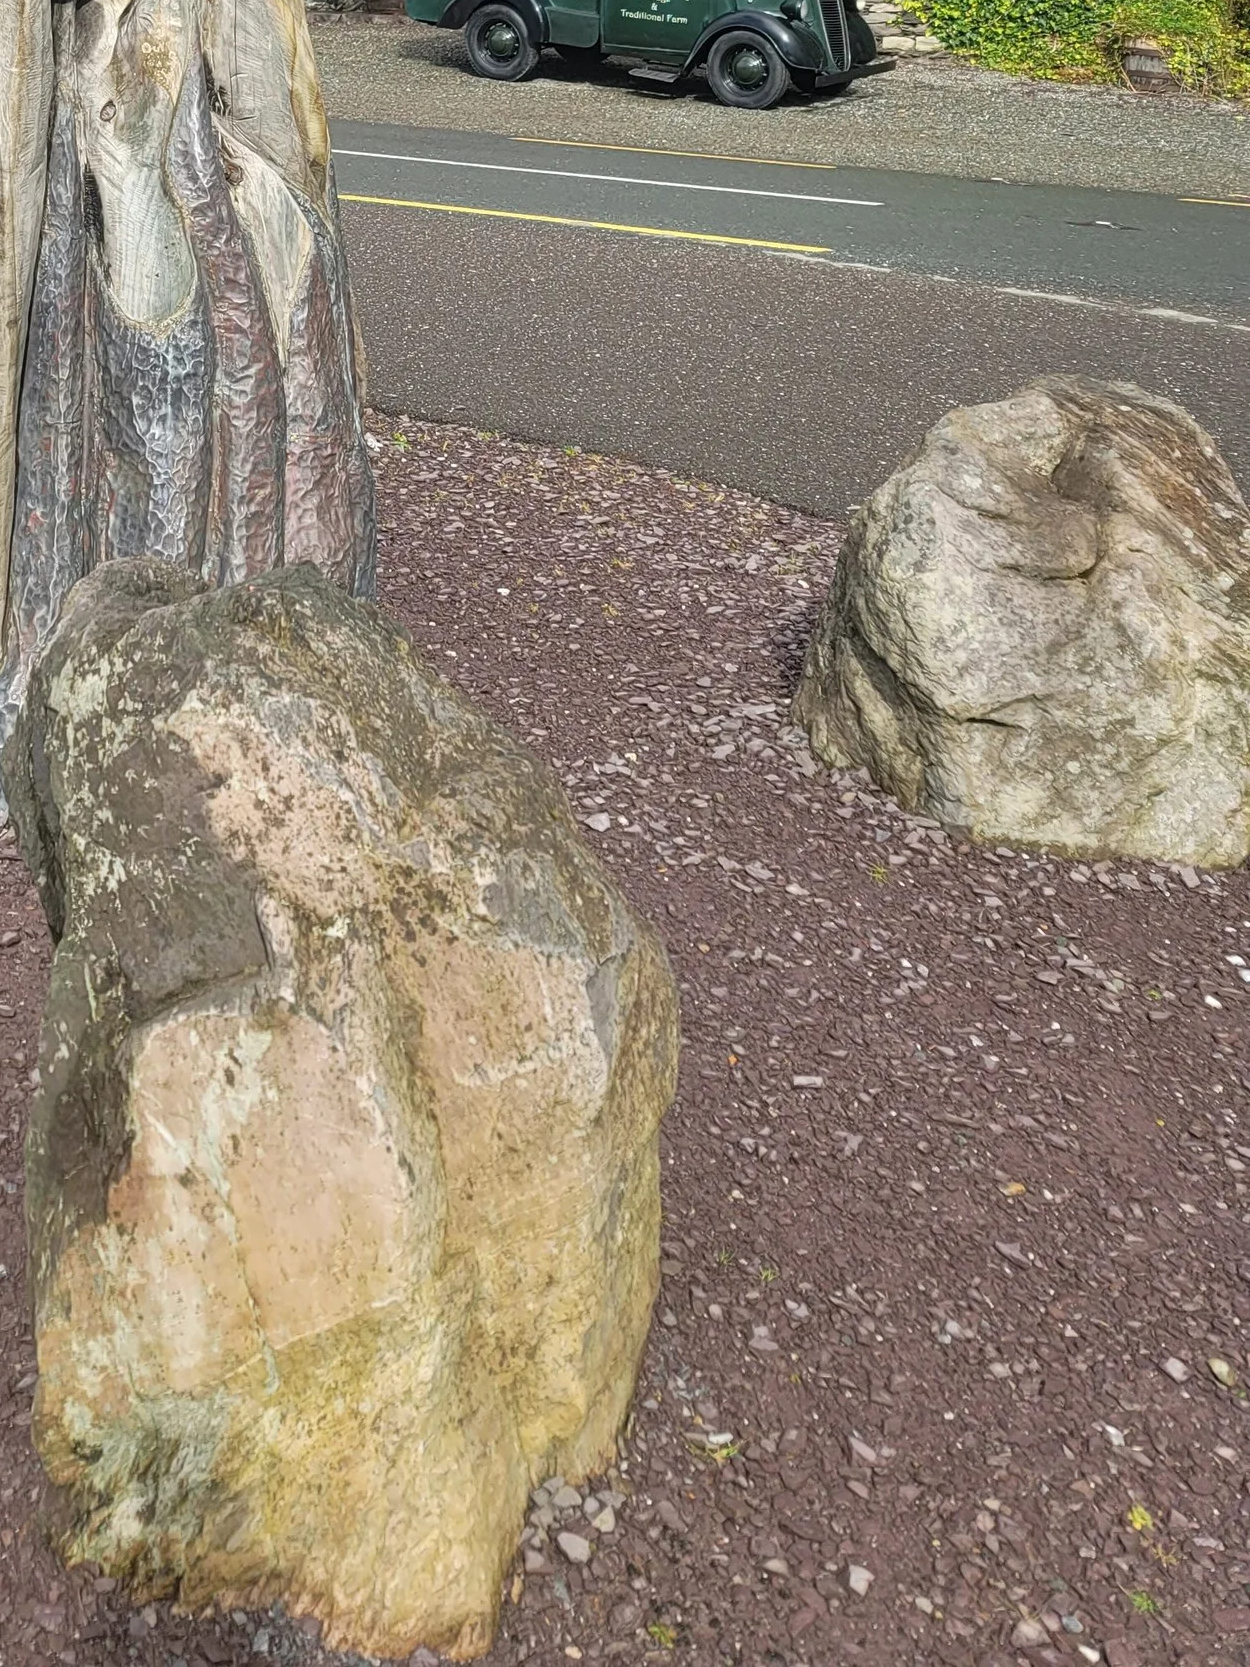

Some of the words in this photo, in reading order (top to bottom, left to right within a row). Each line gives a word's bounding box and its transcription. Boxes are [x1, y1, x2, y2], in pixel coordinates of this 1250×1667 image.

[651, 2, 658, 11] &
[620, 8, 665, 22] Traditional
[666, 14, 688, 24] Farm
